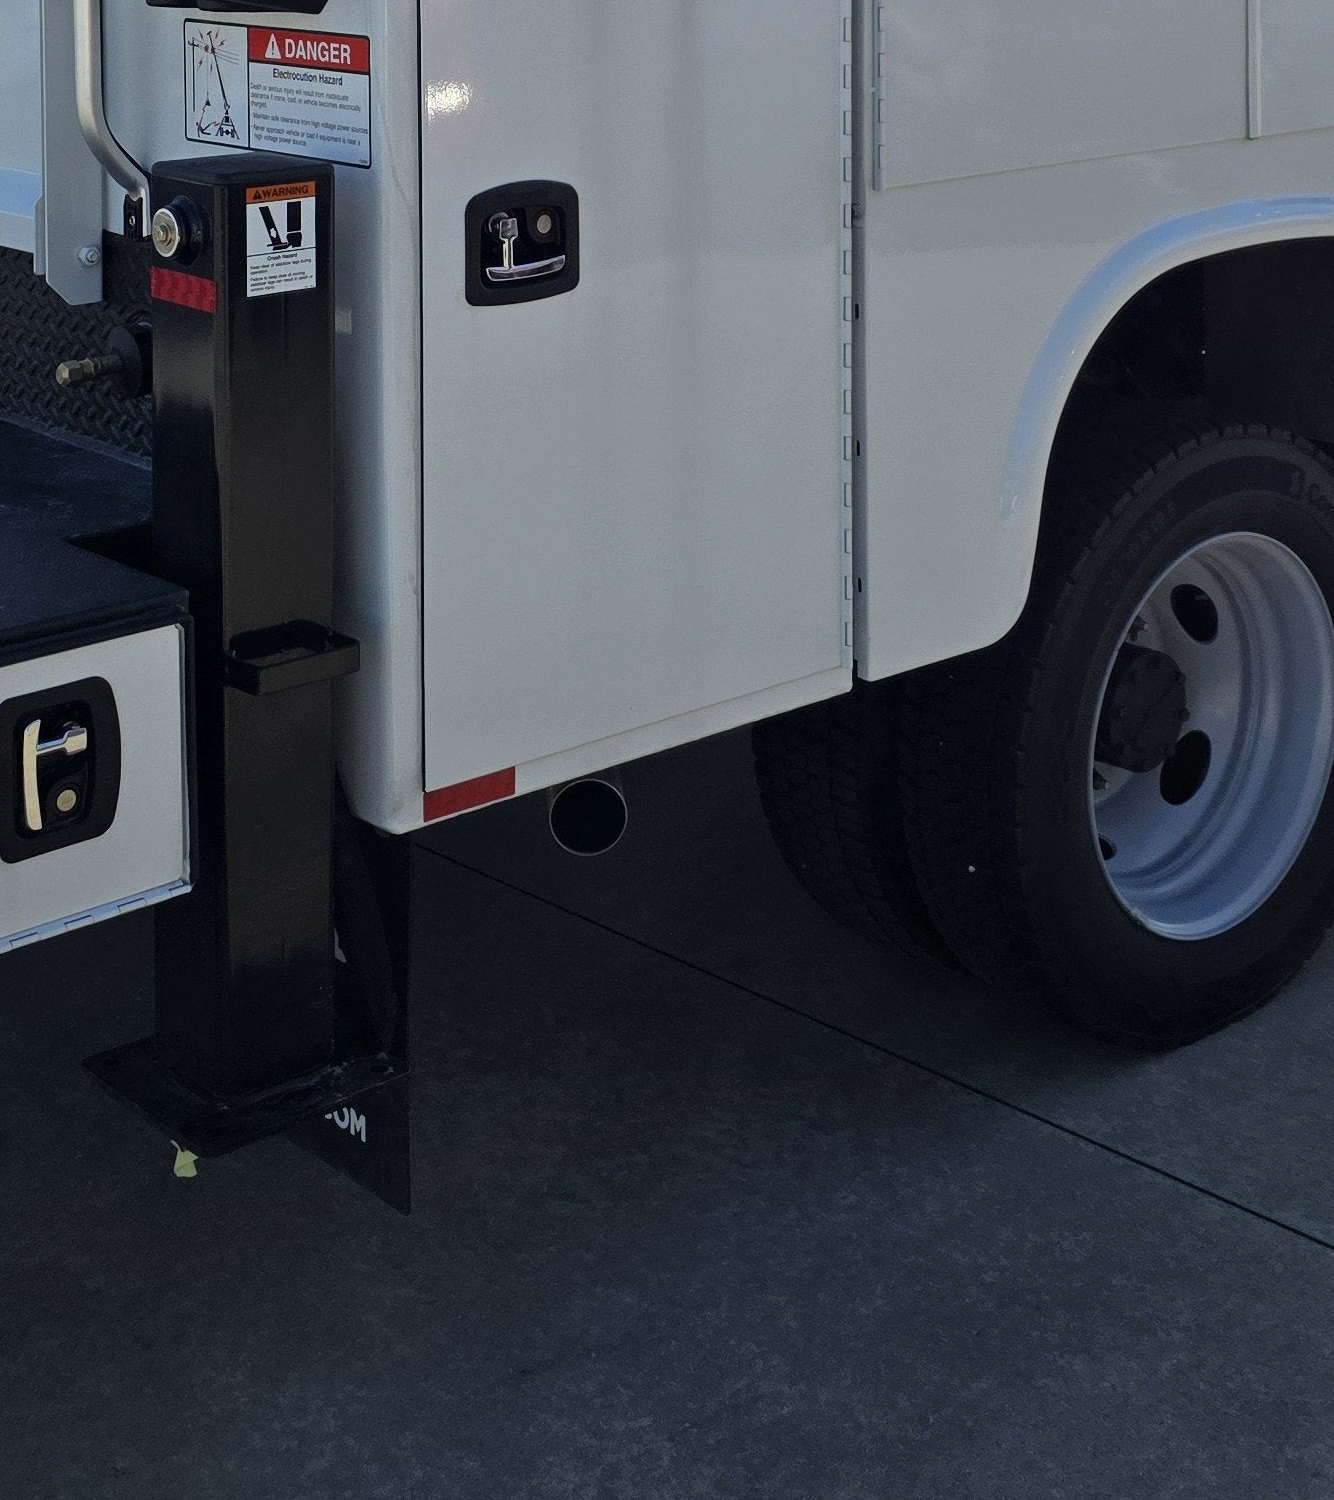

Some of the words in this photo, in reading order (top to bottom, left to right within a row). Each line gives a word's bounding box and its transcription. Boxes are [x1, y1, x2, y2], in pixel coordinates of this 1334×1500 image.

[284, 38, 351, 64] DANGER
[273, 68, 317, 82] Electrocution
[319, 73, 343, 85] Hazard
[262, 185, 308, 198] WARNING
